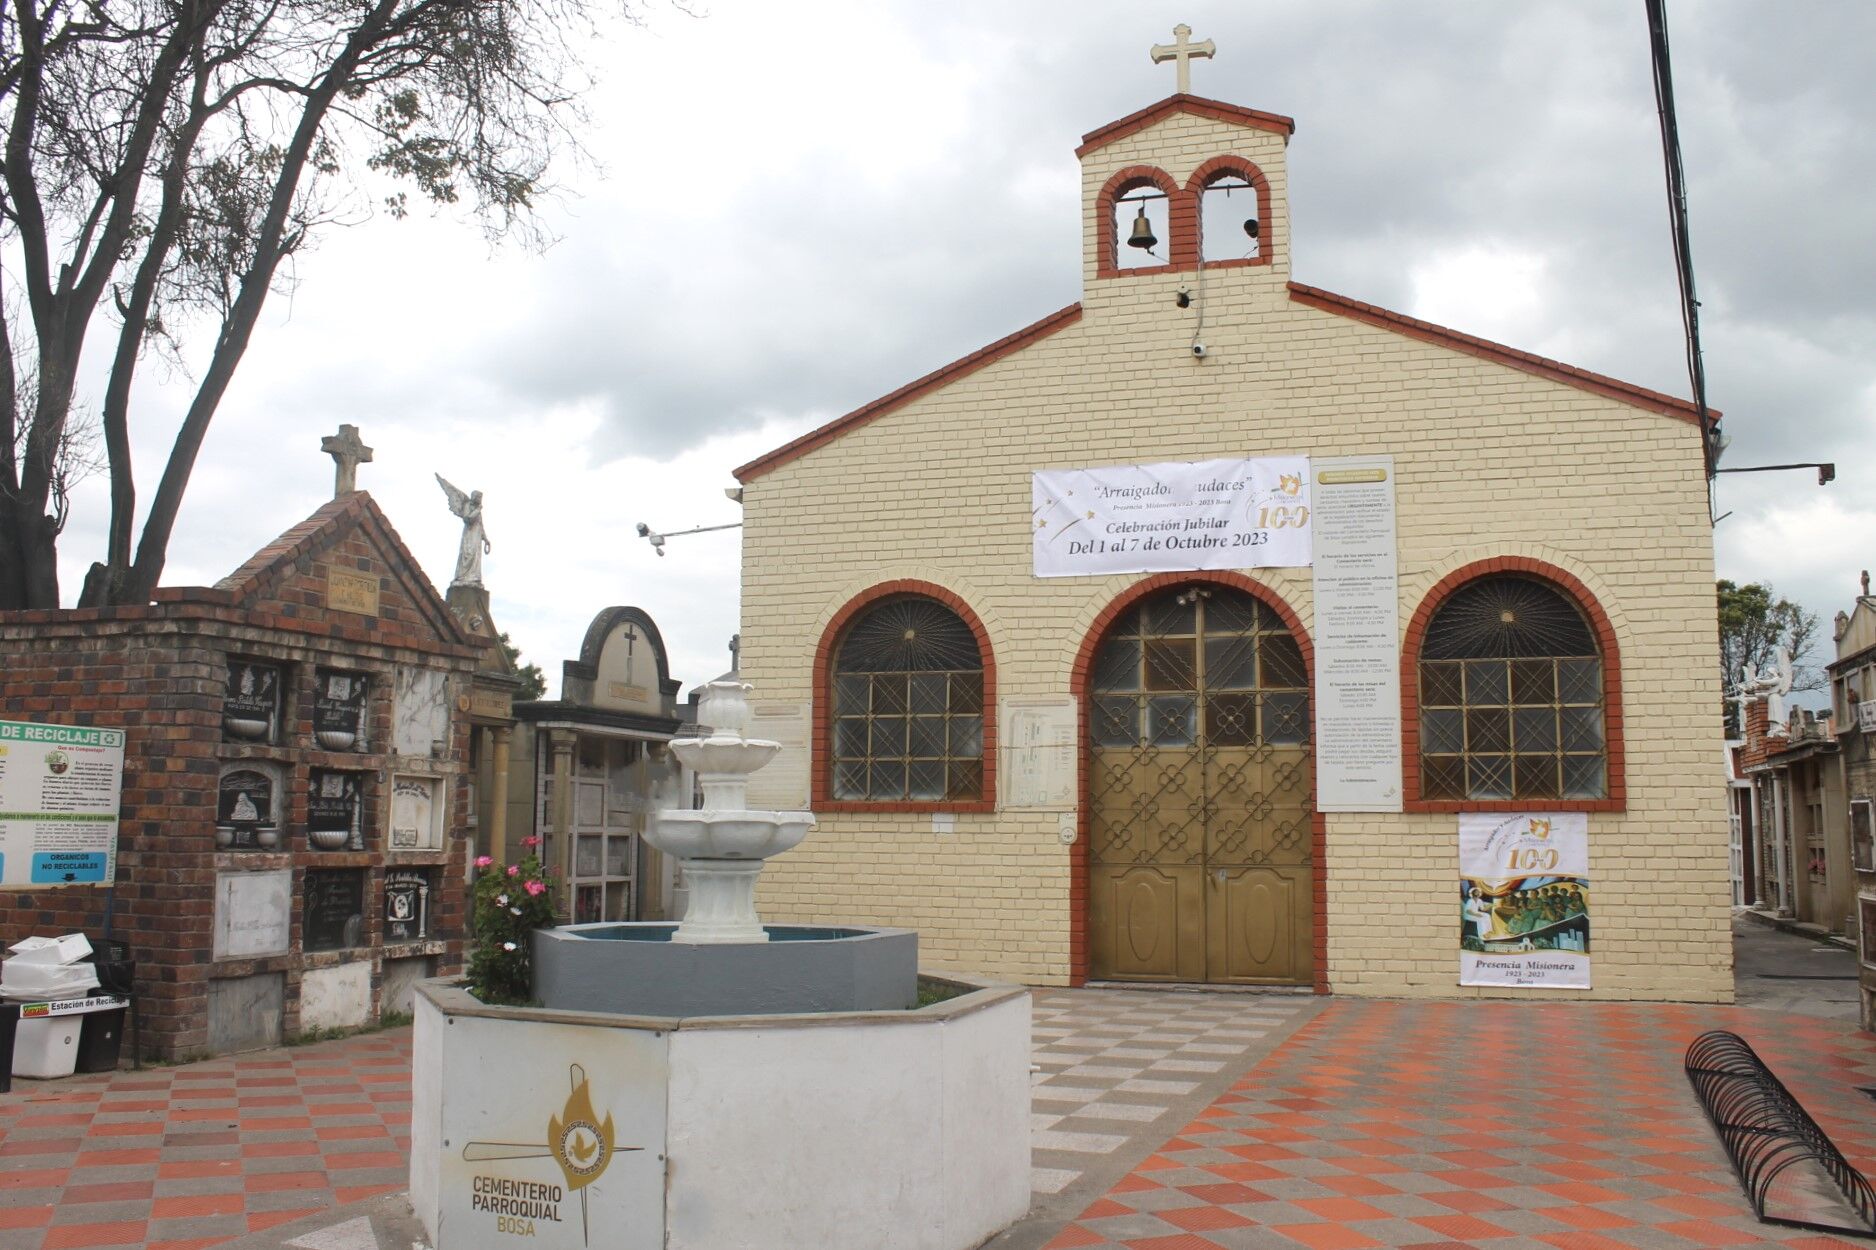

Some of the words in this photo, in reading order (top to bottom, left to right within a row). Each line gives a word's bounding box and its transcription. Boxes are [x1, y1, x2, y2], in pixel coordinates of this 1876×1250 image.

[1197, 476, 1253, 493] udaces”
[1113, 502, 1143, 511] Presencia
[1106, 519, 1181, 535] Celebración
[1183, 517, 1230, 532] Jubilar
[1256, 505, 1309, 529] 100
[1069, 541, 1094, 555] Del
[1099, 541, 1105, 554] 1
[1111, 539, 1126, 553] al
[1130, 539, 1139, 552] 7
[1143, 536, 1161, 551] de
[1165, 534, 1228, 550] Octubre
[1232, 531, 1269, 548] 2023
[1, 725, 21, 739] DE
[25, 726, 99, 745] RECICLAJE
[50, 853, 90, 861] ORGANICOS
[53, 862, 98, 870] RECICLABLES
[1504, 847, 1559, 870] 100
[1475, 959, 1521, 969] Presencia
[1526, 960, 1575, 970] Misionera
[1528, 970, 1545, 978] 2023
[51, 1002, 84, 1011] Estación
[473, 1175, 562, 1203] CEMENTERIO
[472, 1194, 562, 1222] PARROQUIAL
[497, 1216, 536, 1237] BOSA
